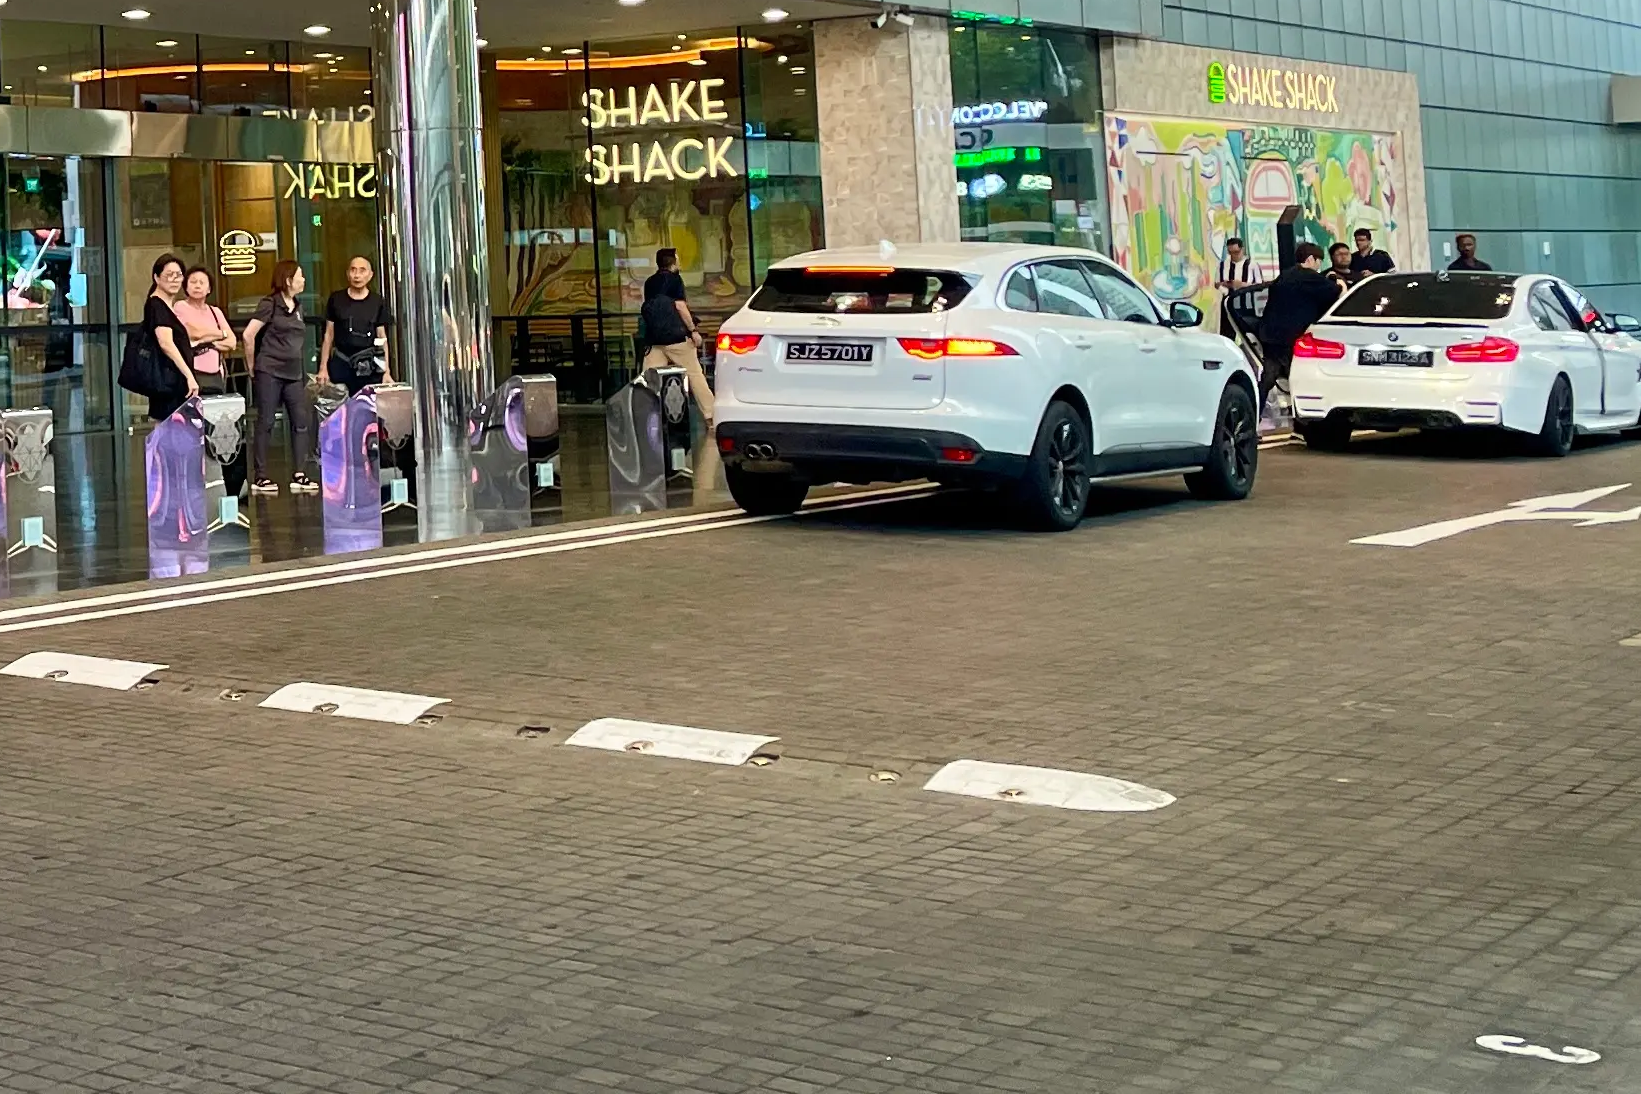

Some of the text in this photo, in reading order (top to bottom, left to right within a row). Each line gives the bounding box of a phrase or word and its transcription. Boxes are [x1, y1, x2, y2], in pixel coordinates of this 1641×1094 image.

[581, 78, 728, 129] SHAKE
[1227, 63, 1339, 113] SHAKE SHACK
[584, 136, 738, 185] SHACK
[789, 345, 871, 360] SJZ5701Y
